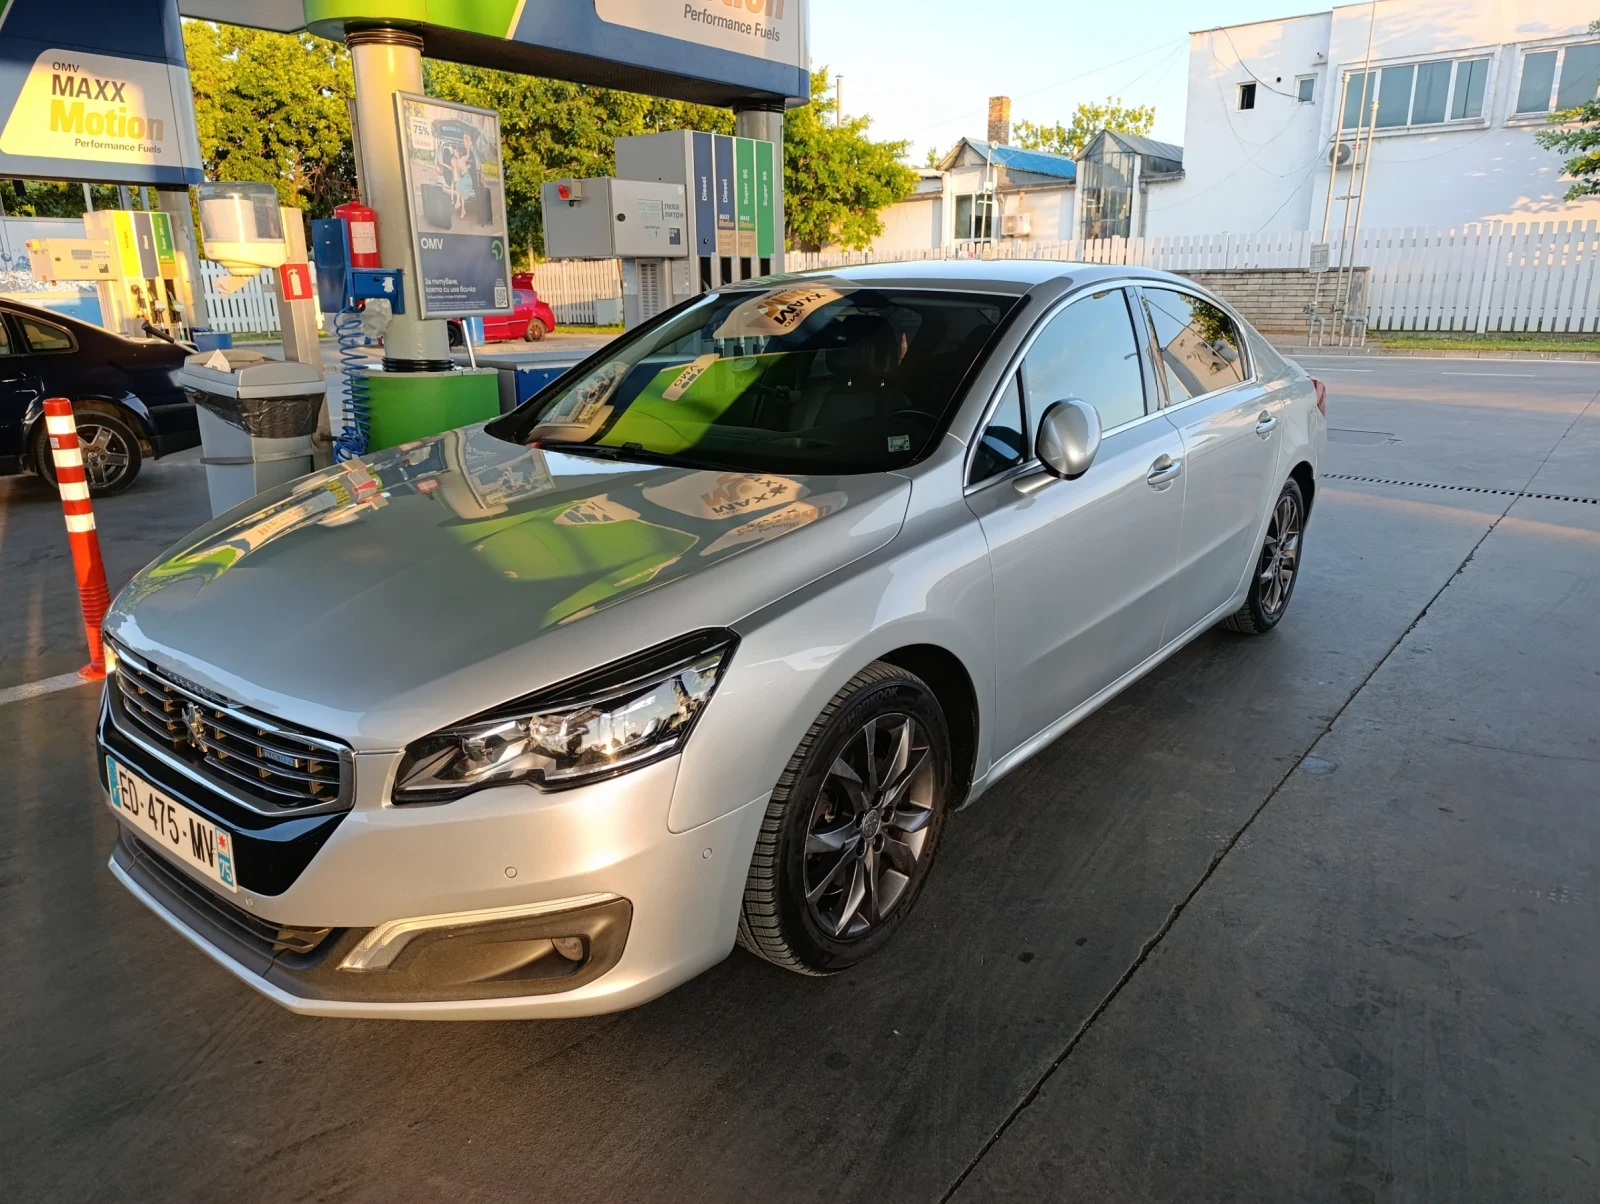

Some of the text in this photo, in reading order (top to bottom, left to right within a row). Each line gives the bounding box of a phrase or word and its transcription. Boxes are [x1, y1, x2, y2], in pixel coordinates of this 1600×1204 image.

[684, 4, 752, 35] Performance
[754, 22, 780, 42] Fuels
[52, 61, 80, 73] OMV
[51, 73, 126, 104] MAXX
[50, 99, 164, 142] Motion
[413, 124, 430, 136] 75%
[74, 137, 163, 155] Performance Fuels
[421, 237, 444, 250] OMV
[219, 860, 233, 882] 75
